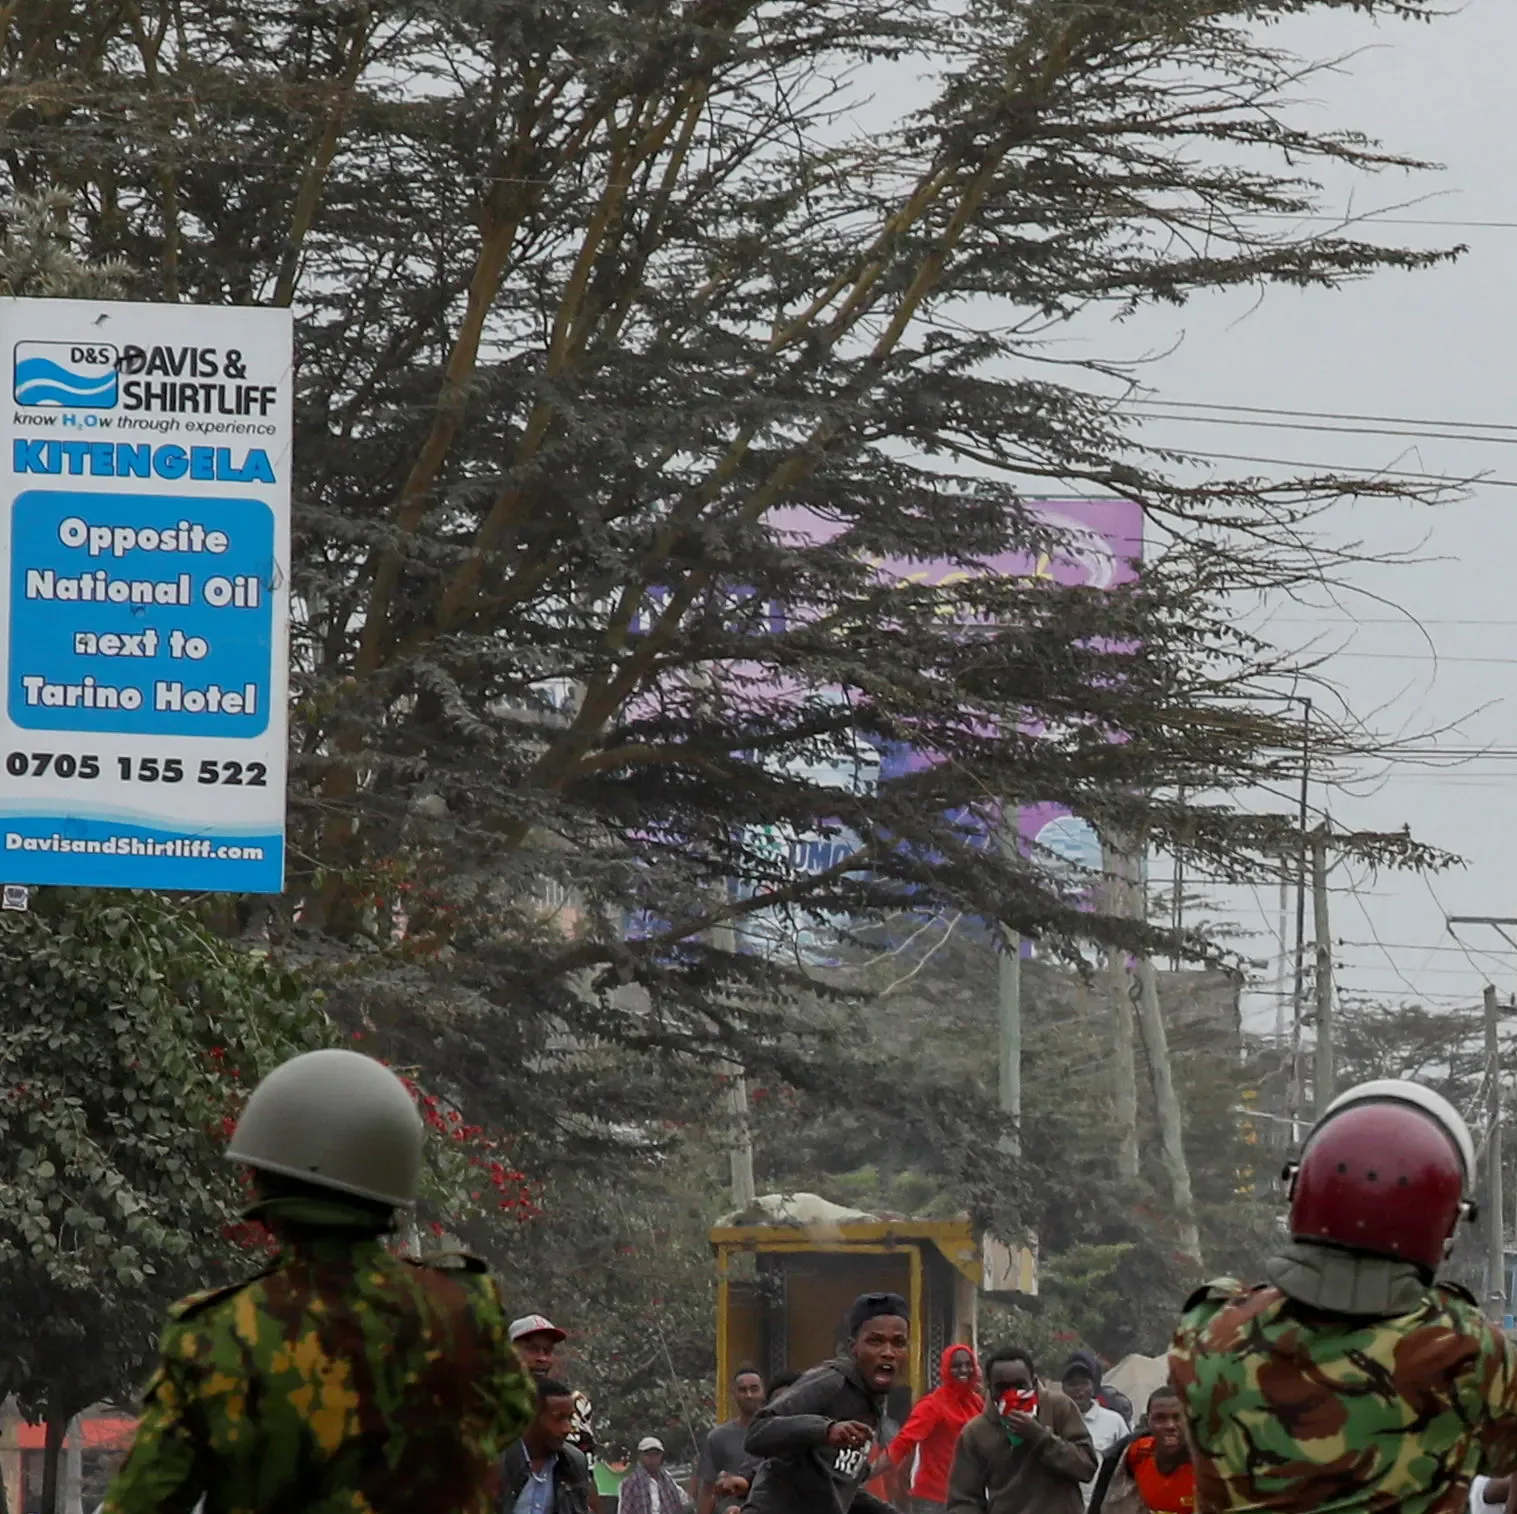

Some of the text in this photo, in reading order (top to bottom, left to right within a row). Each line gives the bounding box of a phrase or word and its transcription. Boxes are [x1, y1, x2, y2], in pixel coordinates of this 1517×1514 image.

[70, 347, 110, 365] D&S
[122, 345, 247, 380] DAVIS &
[123, 381, 277, 416] SHIRTLIFF
[13, 411, 58, 427] know
[117, 415, 181, 434] through
[185, 421, 277, 436] experience
[13, 438, 276, 483] KITENGELA
[58, 516, 229, 557] Opposite
[25, 569, 260, 608] National Oil
[74, 628, 208, 659] next to
[21, 675, 257, 715] Tarino Hotel
[6, 752, 268, 786] 0705 155 522
[5, 832, 264, 860] DavisandShirtliff.com
